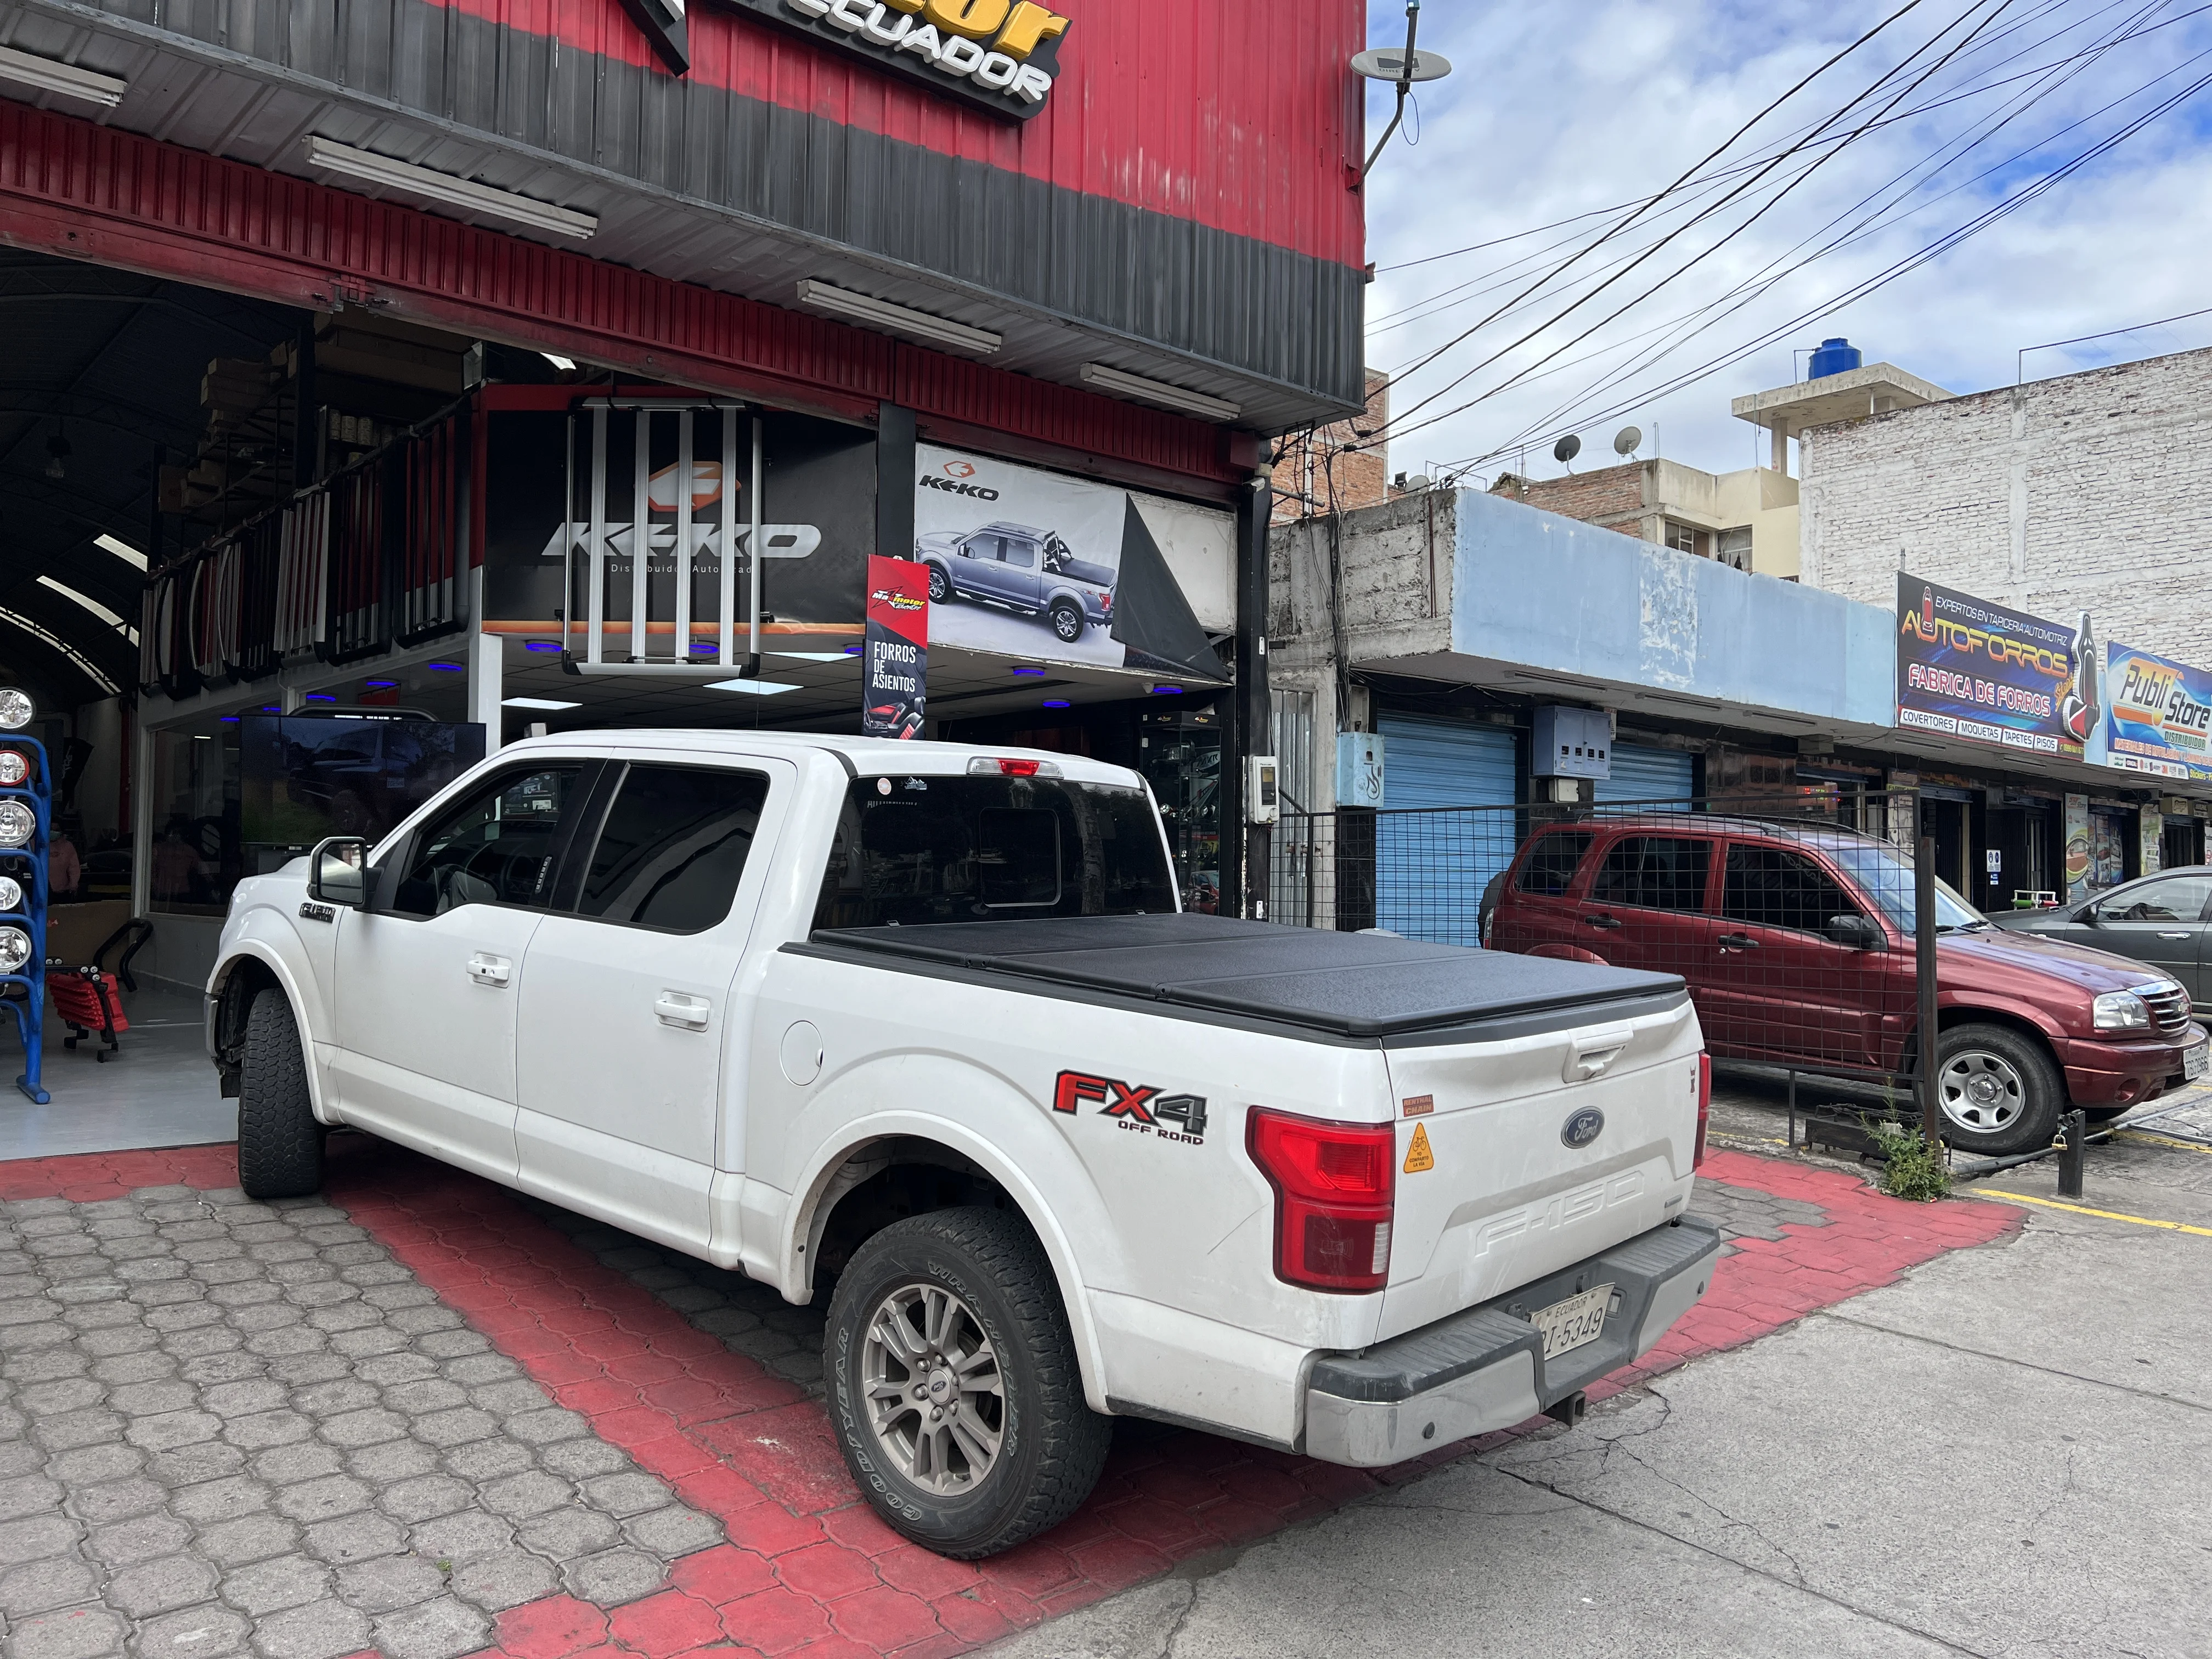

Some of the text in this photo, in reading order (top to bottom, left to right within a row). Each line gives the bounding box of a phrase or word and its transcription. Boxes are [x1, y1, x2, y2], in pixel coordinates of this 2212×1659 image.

[919, 475, 999, 501] KEKO
[541, 522, 822, 558] KEKO
[1936, 596, 2068, 646] EXPERTOS EN TAPICERIA AUTOMOTRIZ
[874, 641, 916, 664] FORROS
[1901, 610, 2068, 678] AUTOFORROS
[873, 659, 885, 674] DE
[872, 674, 916, 692] ASIENTOS
[1909, 663, 2051, 717] FABRICA DE FORROS
[2120, 664, 2171, 709] Publi
[2165, 691, 2211, 729] Store
[1903, 711, 2055, 749] COVERTORES MOQUETAS TAPETES PISOS
[2114, 737, 2145, 754] MATERIALES
[2164, 731, 2206, 751] DISTRIBUIDOR
[1053, 1069, 1208, 1138] FX4
[1404, 1096, 1432, 1106] RENTHAL
[1406, 1104, 1432, 1115] CHAIN
[1118, 1120, 1204, 1146] OFF ROAD
[1575, 1116, 1599, 1141] Ford
[1475, 1170, 1644, 1257] F-150
[1555, 1296, 1587, 1318] ECUADOR
[928, 1262, 1020, 1457] WRANGLER
[836, 1327, 922, 1522] GOODYEAR
